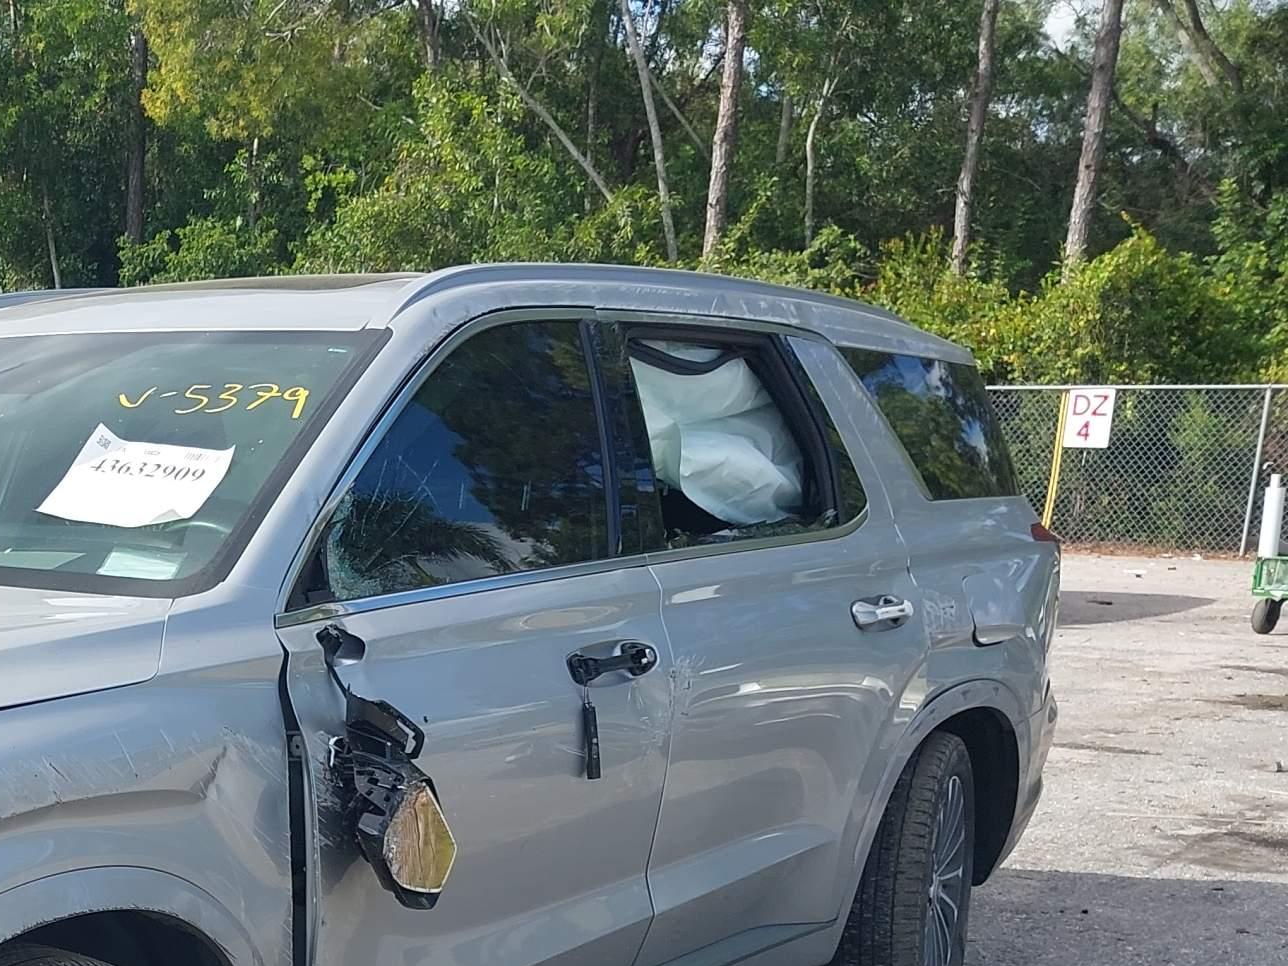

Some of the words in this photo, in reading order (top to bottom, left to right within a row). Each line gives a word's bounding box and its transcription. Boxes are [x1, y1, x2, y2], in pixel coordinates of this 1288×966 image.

[1073, 395, 1109, 416] DZ
[1077, 421, 1090, 441] 4
[90, 458, 206, 481] 43632909
